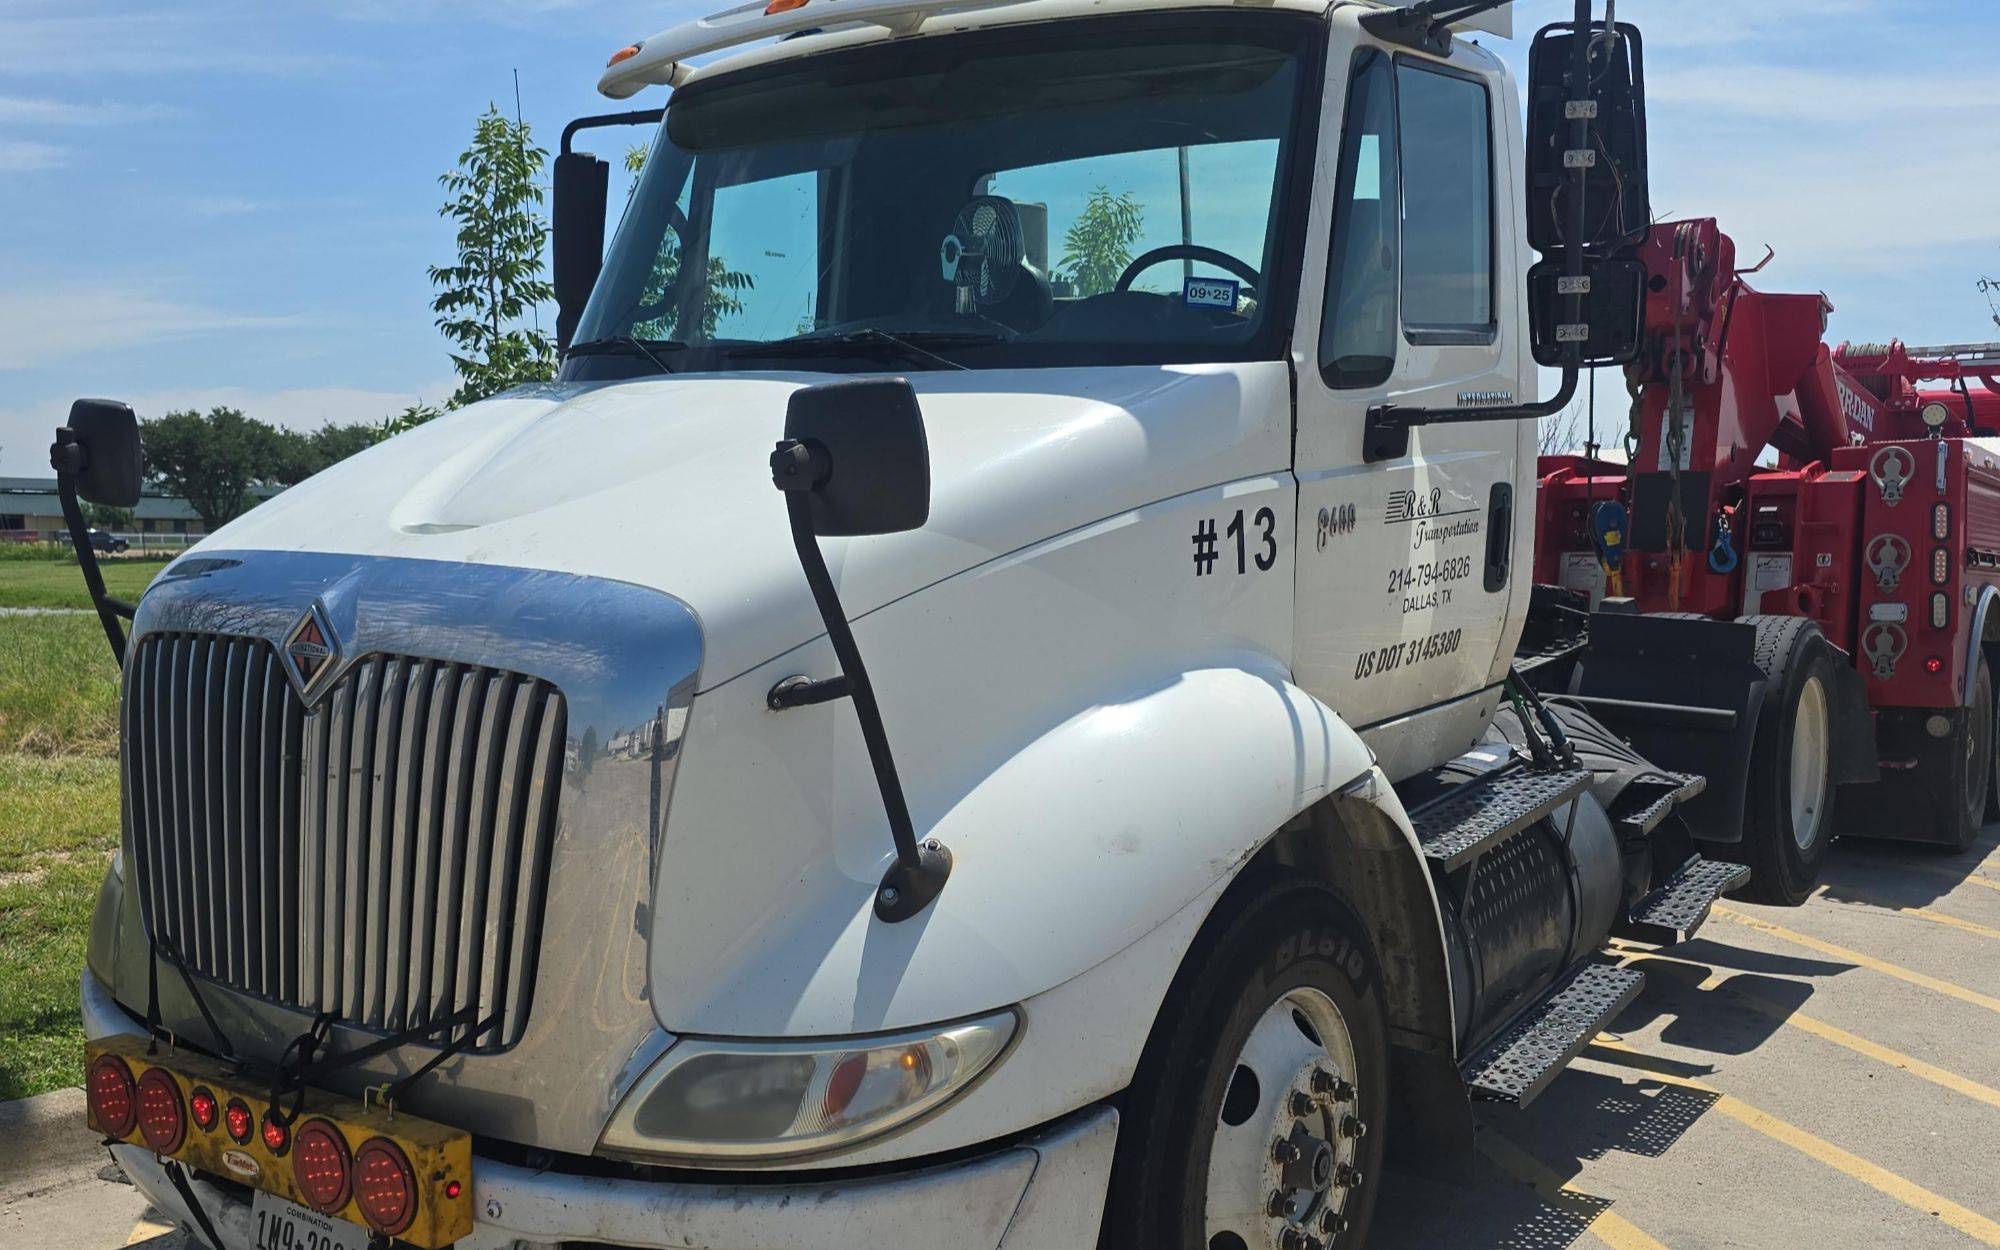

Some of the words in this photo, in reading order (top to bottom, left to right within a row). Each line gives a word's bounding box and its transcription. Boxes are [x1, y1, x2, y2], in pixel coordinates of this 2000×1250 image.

[1401, 489, 1416, 519] R
[1417, 495, 1427, 516] &
[1428, 487, 1441, 515] R
[1191, 506, 1277, 576] #13
[1413, 518, 1480, 550] Transportation
[1387, 555, 1470, 593] 214-794-6826
[1402, 591, 1439, 614] DALLAS,
[1442, 589, 1453, 605] TX
[1354, 650, 1376, 680] US
[1375, 642, 1407, 674] DOT
[1406, 627, 1462, 666] 3145380
[286, 1206, 334, 1233] COMBINATION
